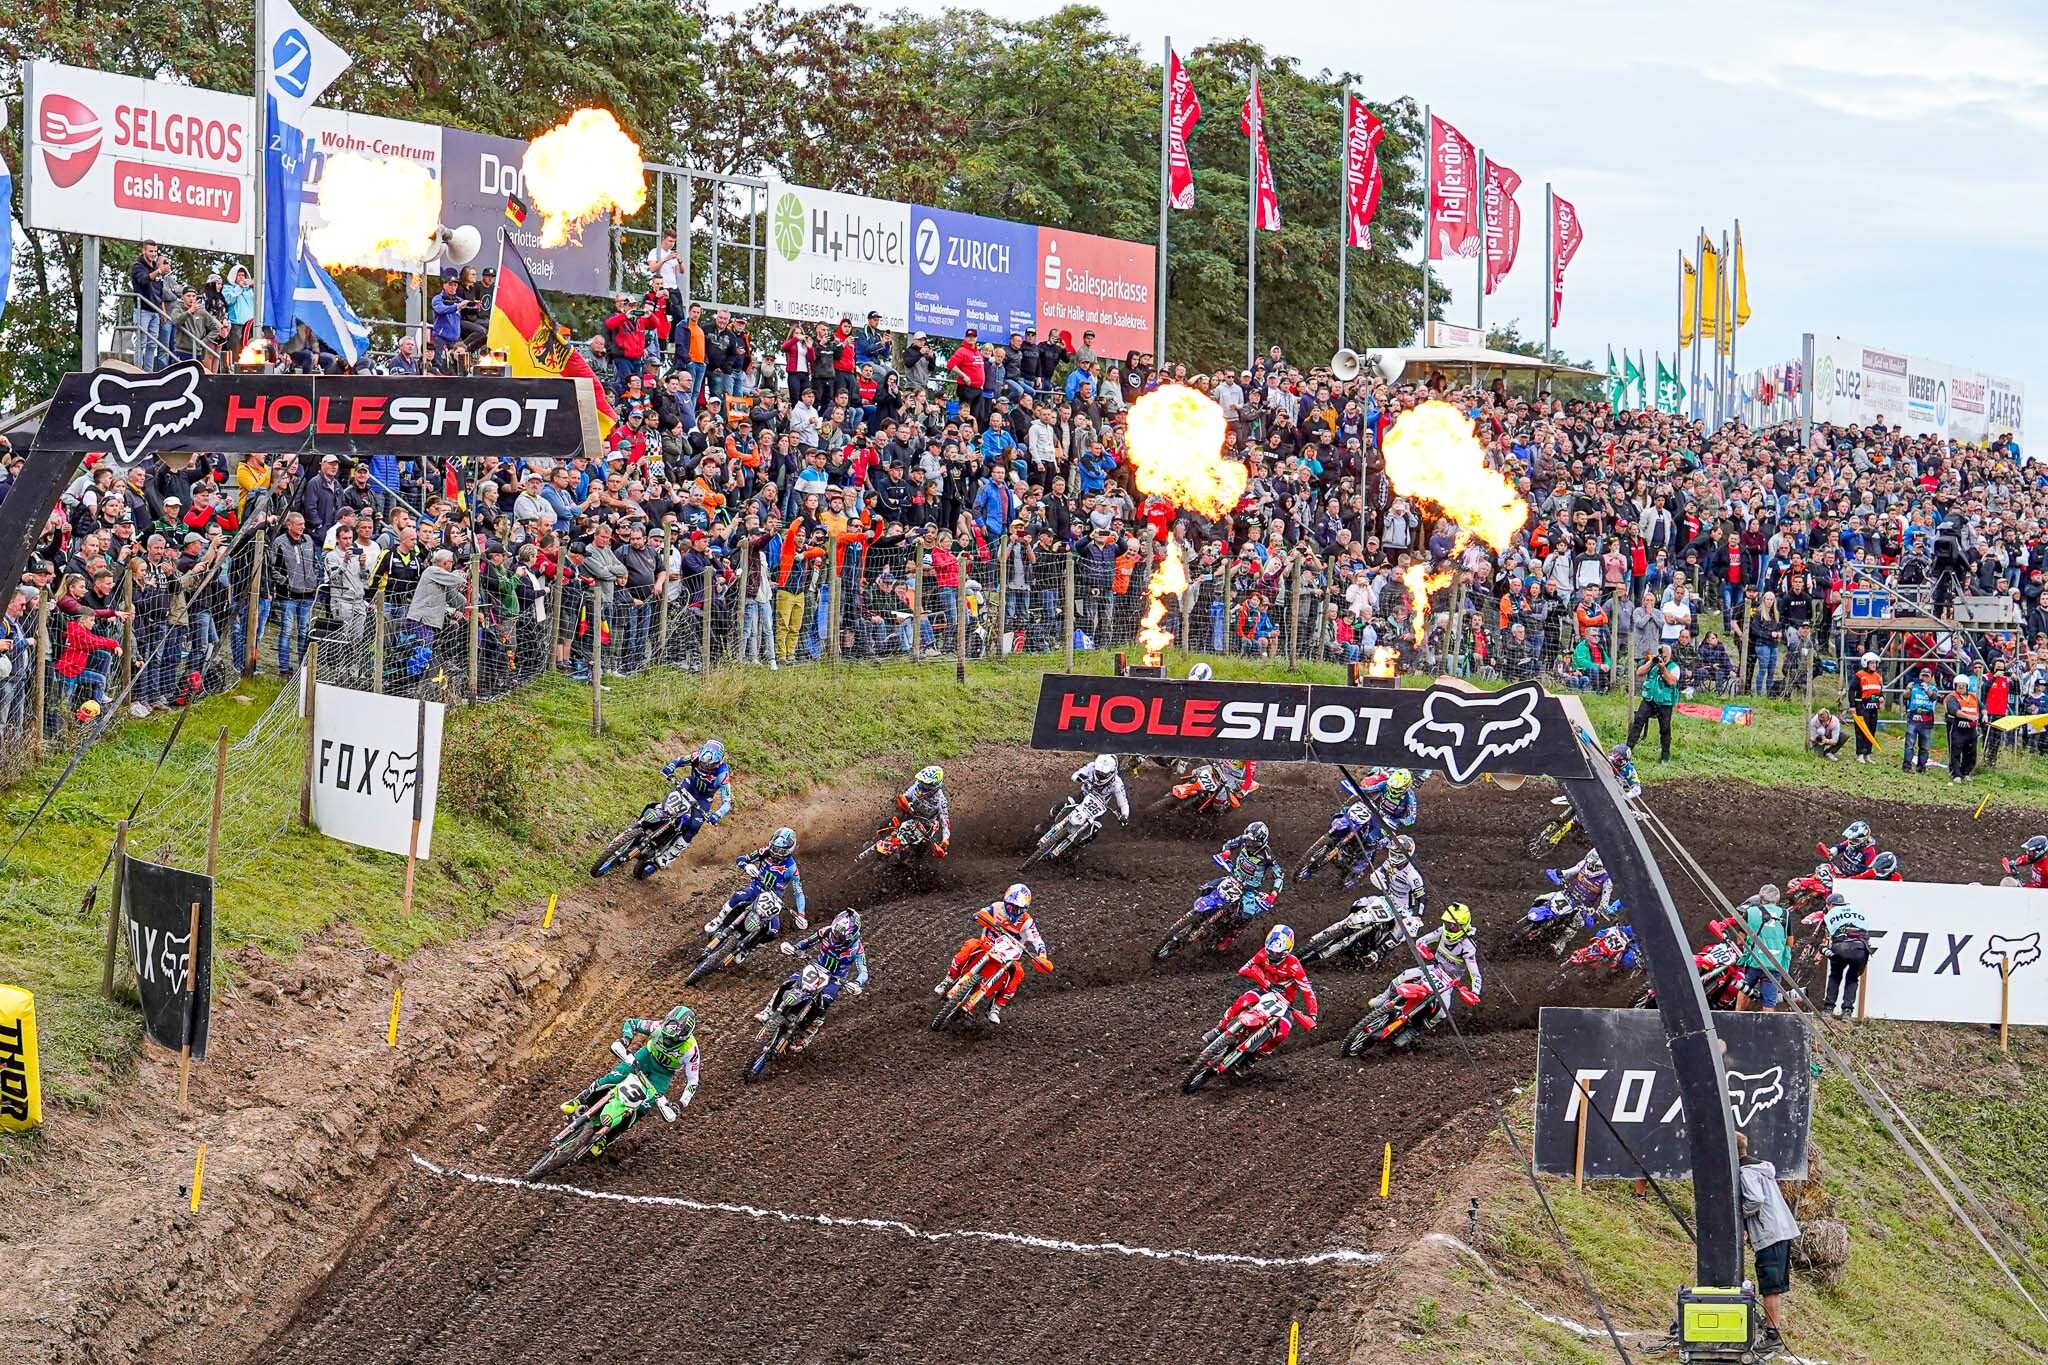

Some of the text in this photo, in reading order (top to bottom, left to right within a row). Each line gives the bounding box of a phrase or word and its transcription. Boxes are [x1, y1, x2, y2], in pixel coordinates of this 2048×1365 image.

[114, 105, 242, 163] SELGROS
[321, 131, 436, 161] Wohn-Centrum
[123, 173, 233, 216] cash & carry
[947, 236, 1010, 273] ZURICH
[810, 272, 867, 296] Leipzig-Halle
[1065, 268, 1148, 303] Saalesparkasse
[1043, 301, 1056, 317] Gut
[1056, 302, 1067, 317] für
[1067, 305, 1085, 321] Halle
[1086, 309, 1098, 323] und
[1099, 310, 1112, 325] den
[1908, 374, 1936, 402] WEBER
[224, 395, 559, 438] HOLESHOT
[1057, 693, 1393, 746] HOLESHOT
[320, 739, 380, 796] FOX
[1350, 806, 1370, 821] 22
[760, 895, 780, 916] 259
[1829, 912, 1865, 924] PHOTO
[126, 916, 158, 983] OX
[1711, 947, 1731, 966] 189
[1261, 1000, 1284, 1015] 41
[620, 1083, 648, 1102] 3
